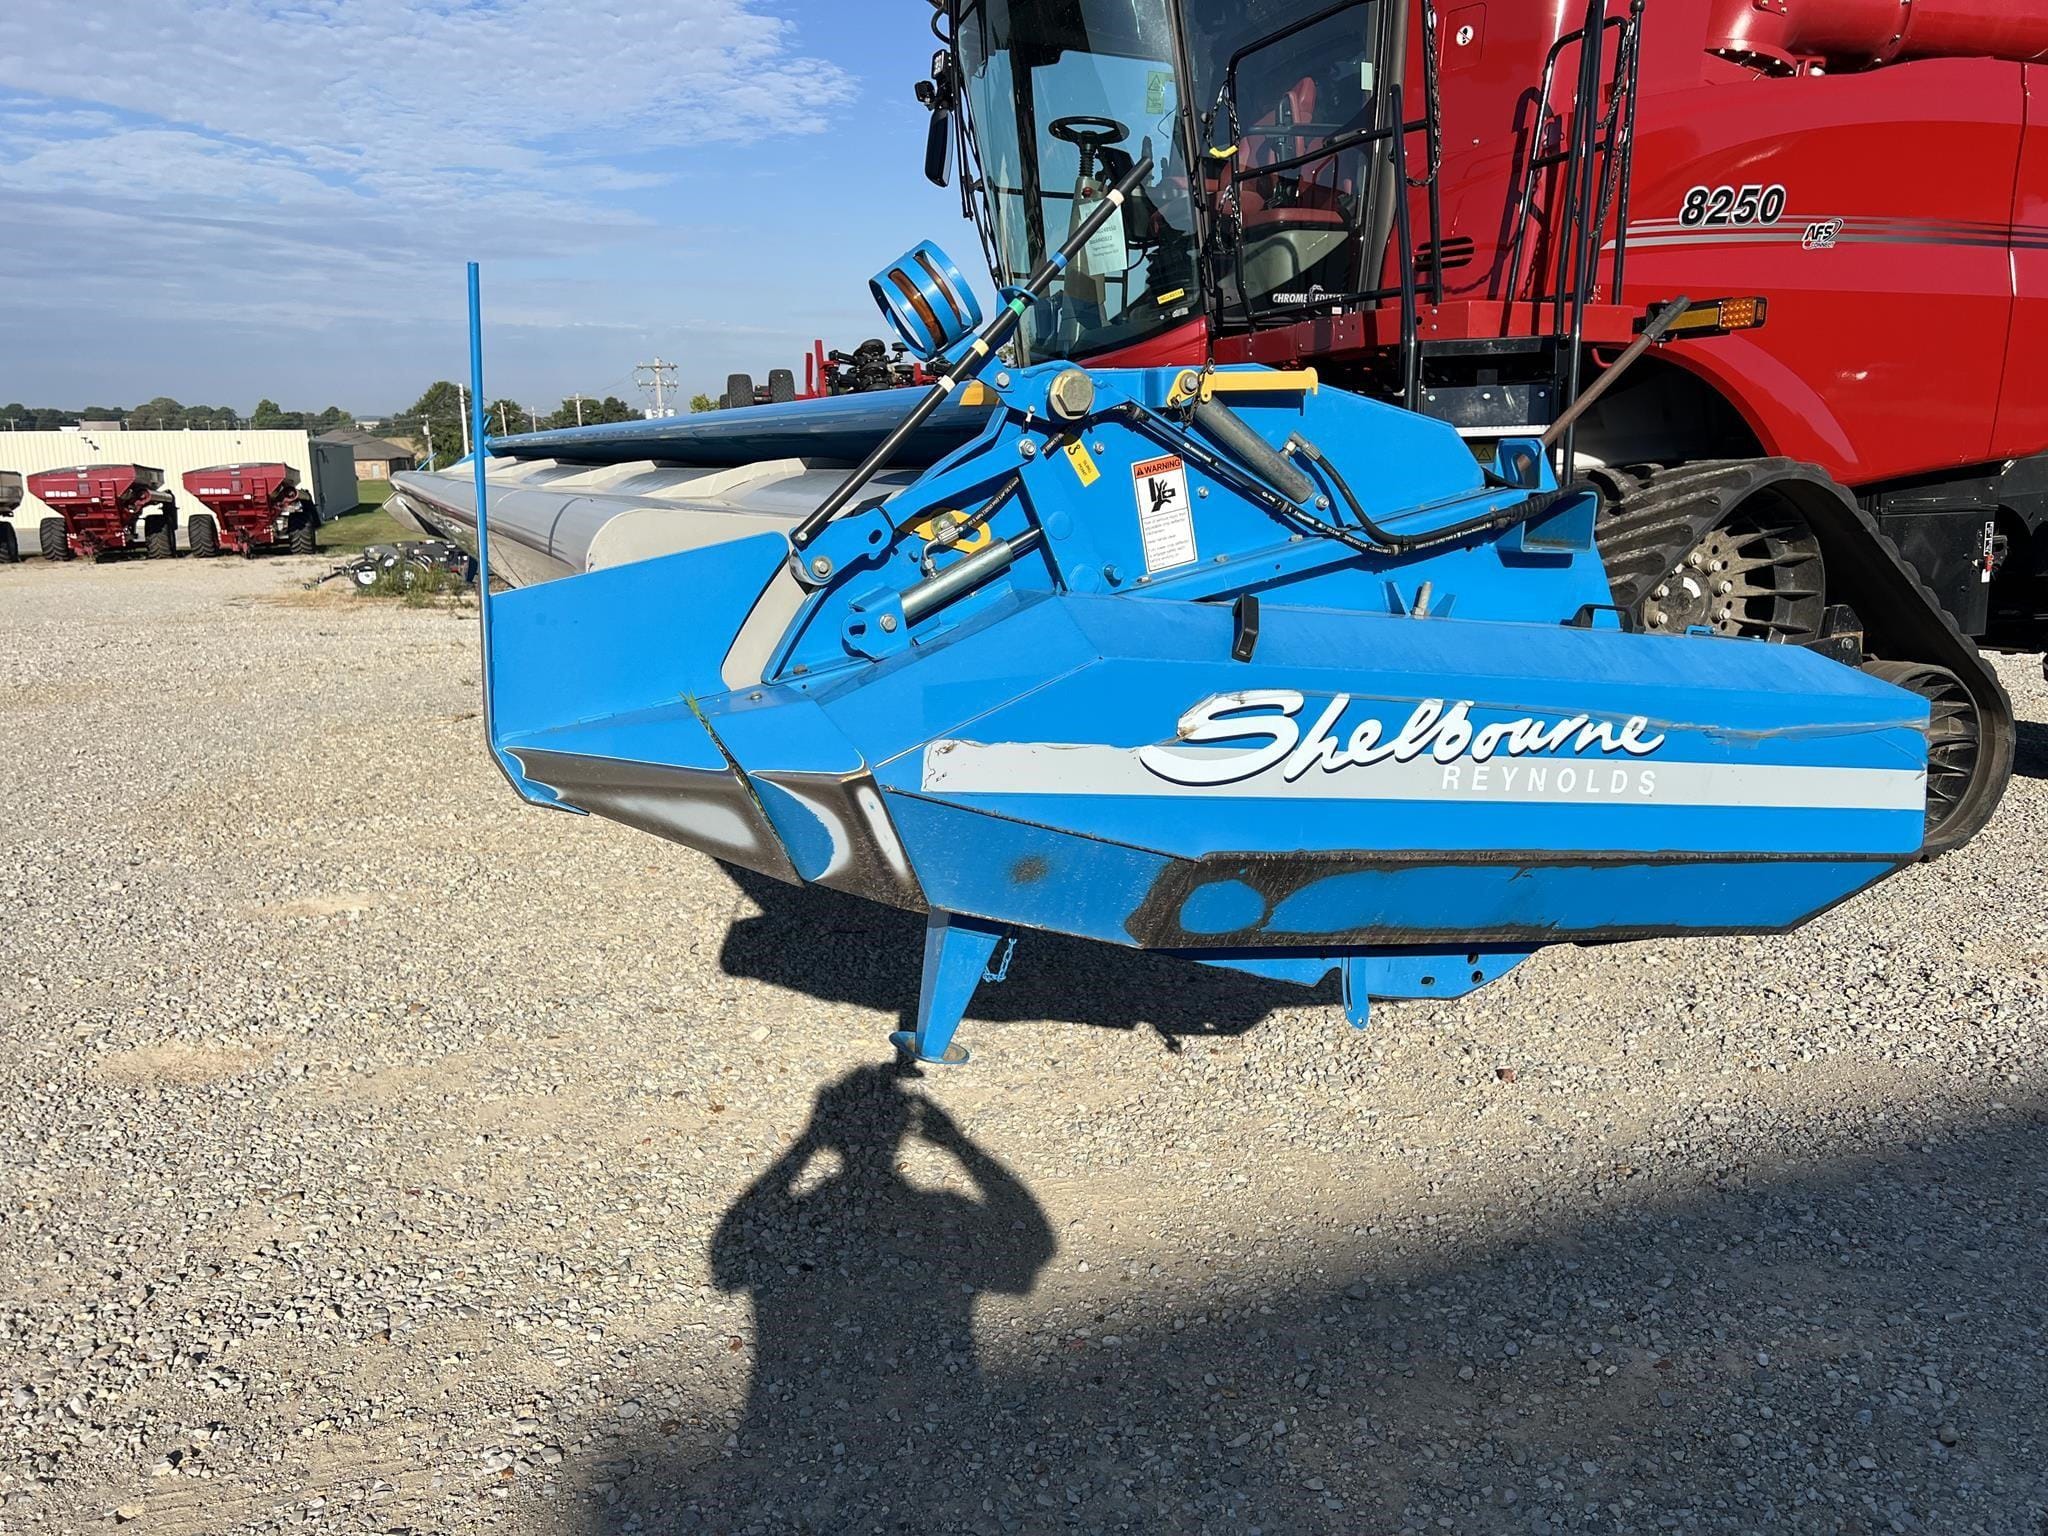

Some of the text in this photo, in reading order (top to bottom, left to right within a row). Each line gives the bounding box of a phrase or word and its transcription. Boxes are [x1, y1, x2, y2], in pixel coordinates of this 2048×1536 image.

[1679, 184, 1787, 228] 8250
[1803, 223, 1835, 241] AFS
[1272, 293, 1308, 304] CHROME
[1143, 459, 1181, 475] WARNING
[1139, 688, 1666, 787] Shelbourne
[1441, 764, 1658, 796] REYNOLDS
